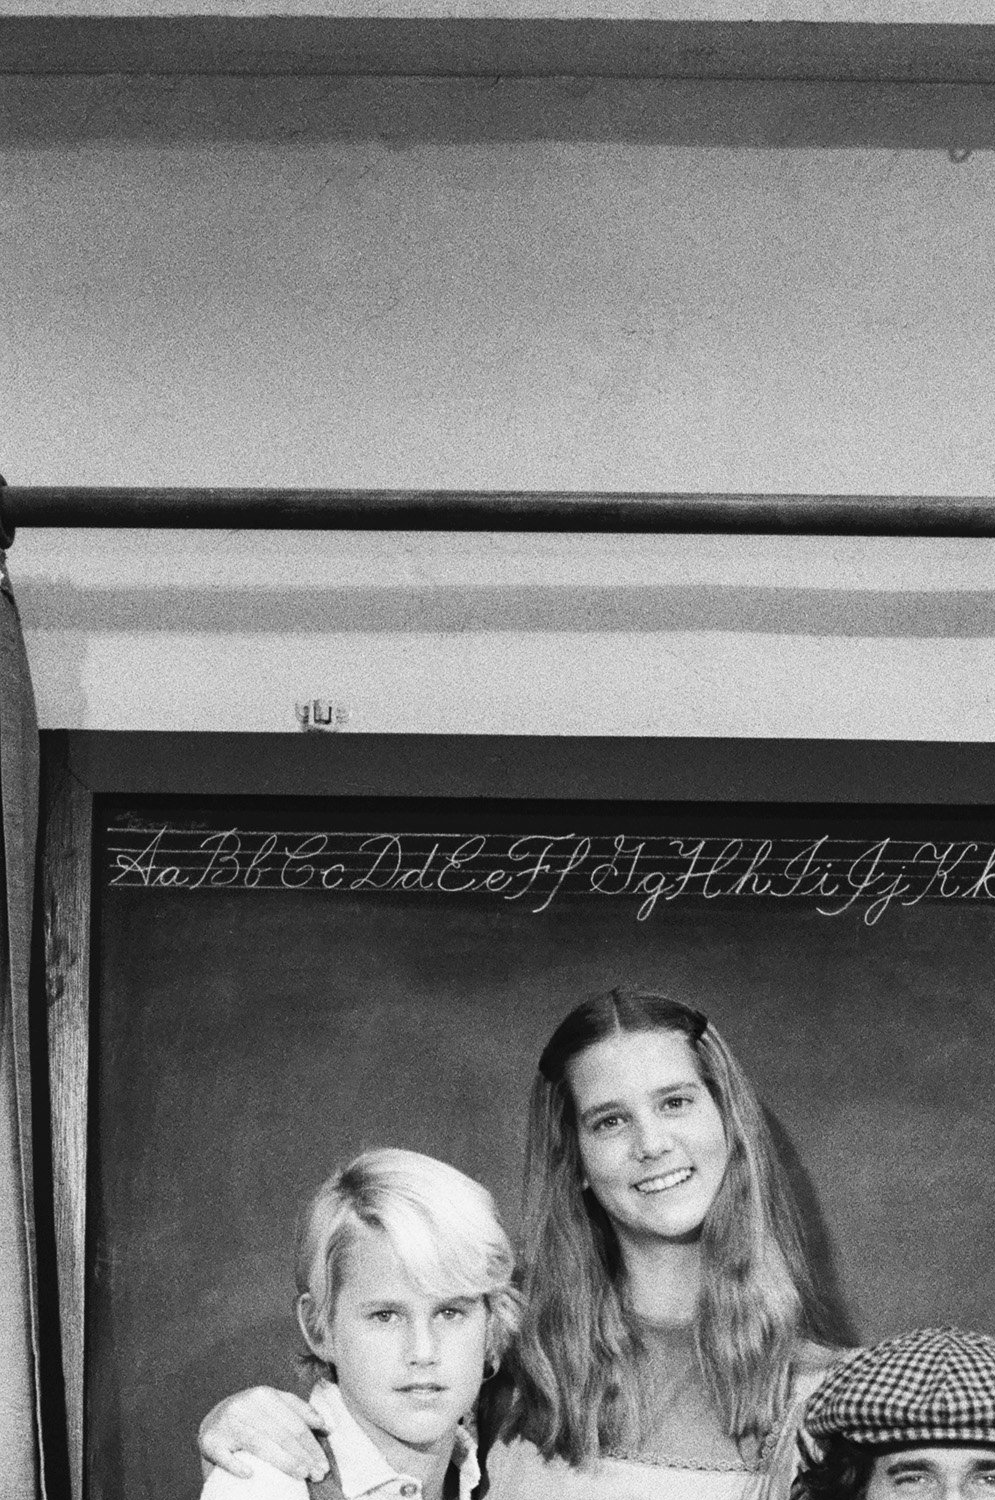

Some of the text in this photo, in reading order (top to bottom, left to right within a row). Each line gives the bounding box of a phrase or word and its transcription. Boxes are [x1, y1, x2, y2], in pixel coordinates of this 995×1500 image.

[110, 825, 191, 886] Aa
[189, 828, 278, 889] Bb
[281, 834, 345, 888] Cc
[350, 834, 439, 889] Dd
[438, 836, 512, 891] Ee
[504, 833, 591, 912] Ff
[590, 834, 674, 921] Gg
[666, 839, 772, 900] Hh
[816, 838, 910, 925] Jj
